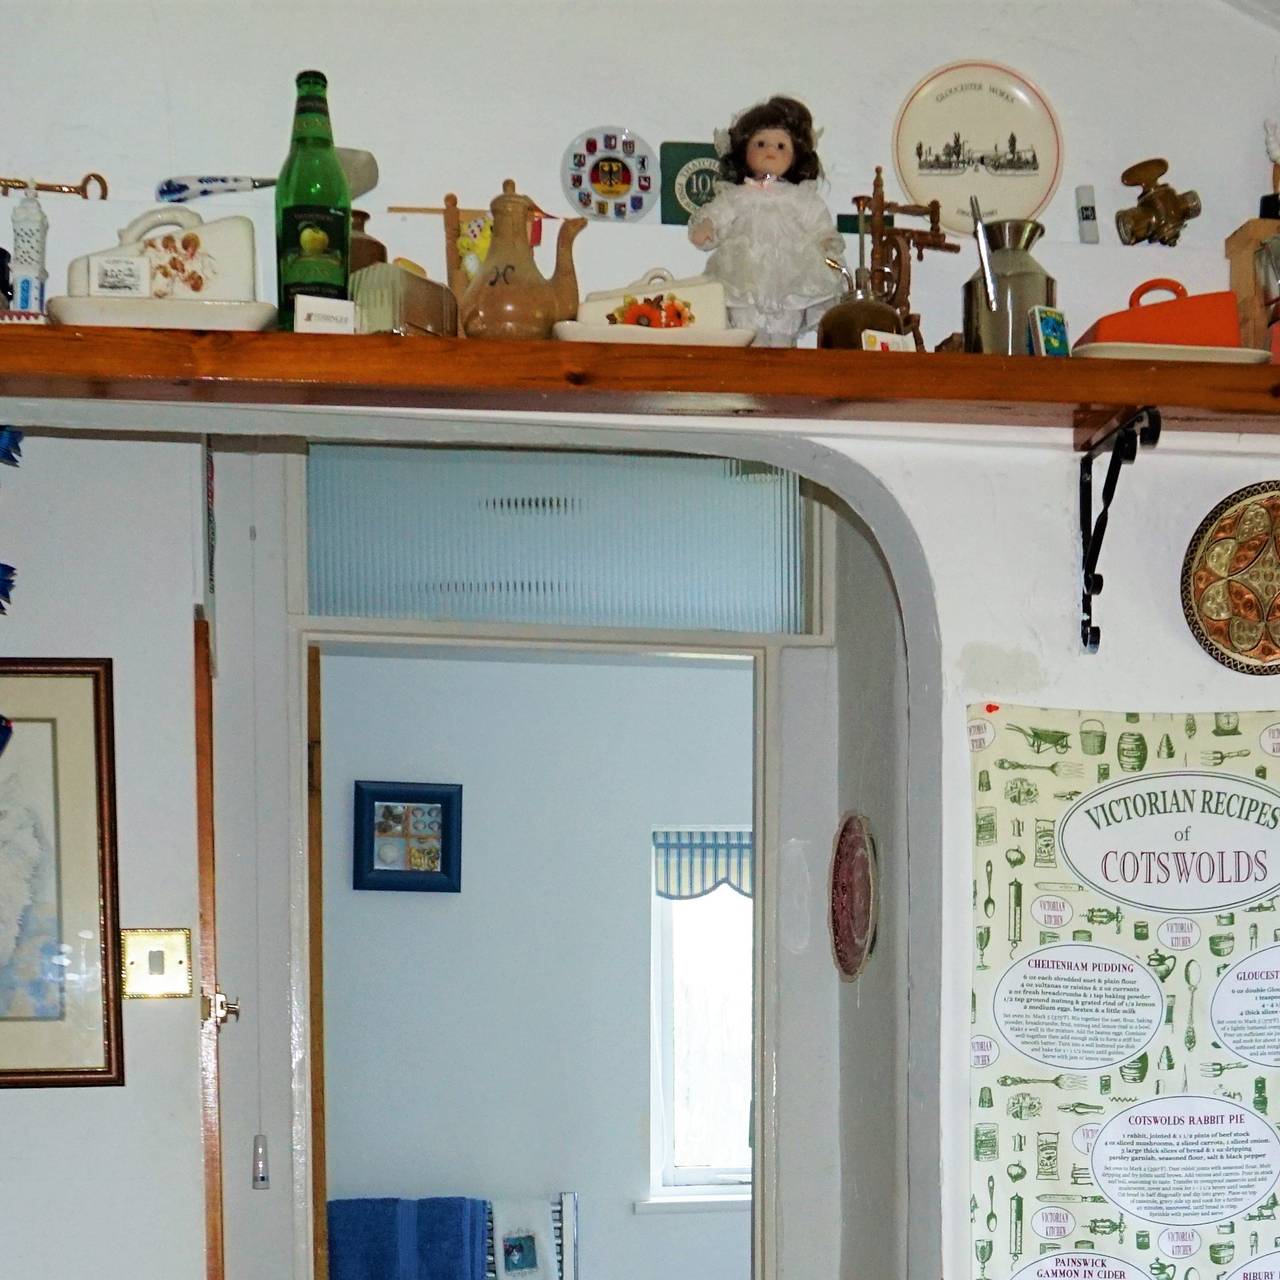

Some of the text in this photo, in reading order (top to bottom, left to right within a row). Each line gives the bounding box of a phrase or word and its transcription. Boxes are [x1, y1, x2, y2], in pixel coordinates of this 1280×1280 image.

[1084, 789, 1196, 831] VICTORIAN
[1174, 826, 1192, 842] of
[1101, 850, 1268, 884] COTSWOLDS
[1028, 959, 1134, 973] CHELTENHAM PUDDING
[1128, 1114, 1245, 1126] COTSWOLDS RABBIT PIE
[1055, 1257, 1107, 1268] PAINSWICK
[1036, 1268, 1126, 1280] GAMMON IN CIDER
[1242, 1271, 1274, 1280] BIBURY
